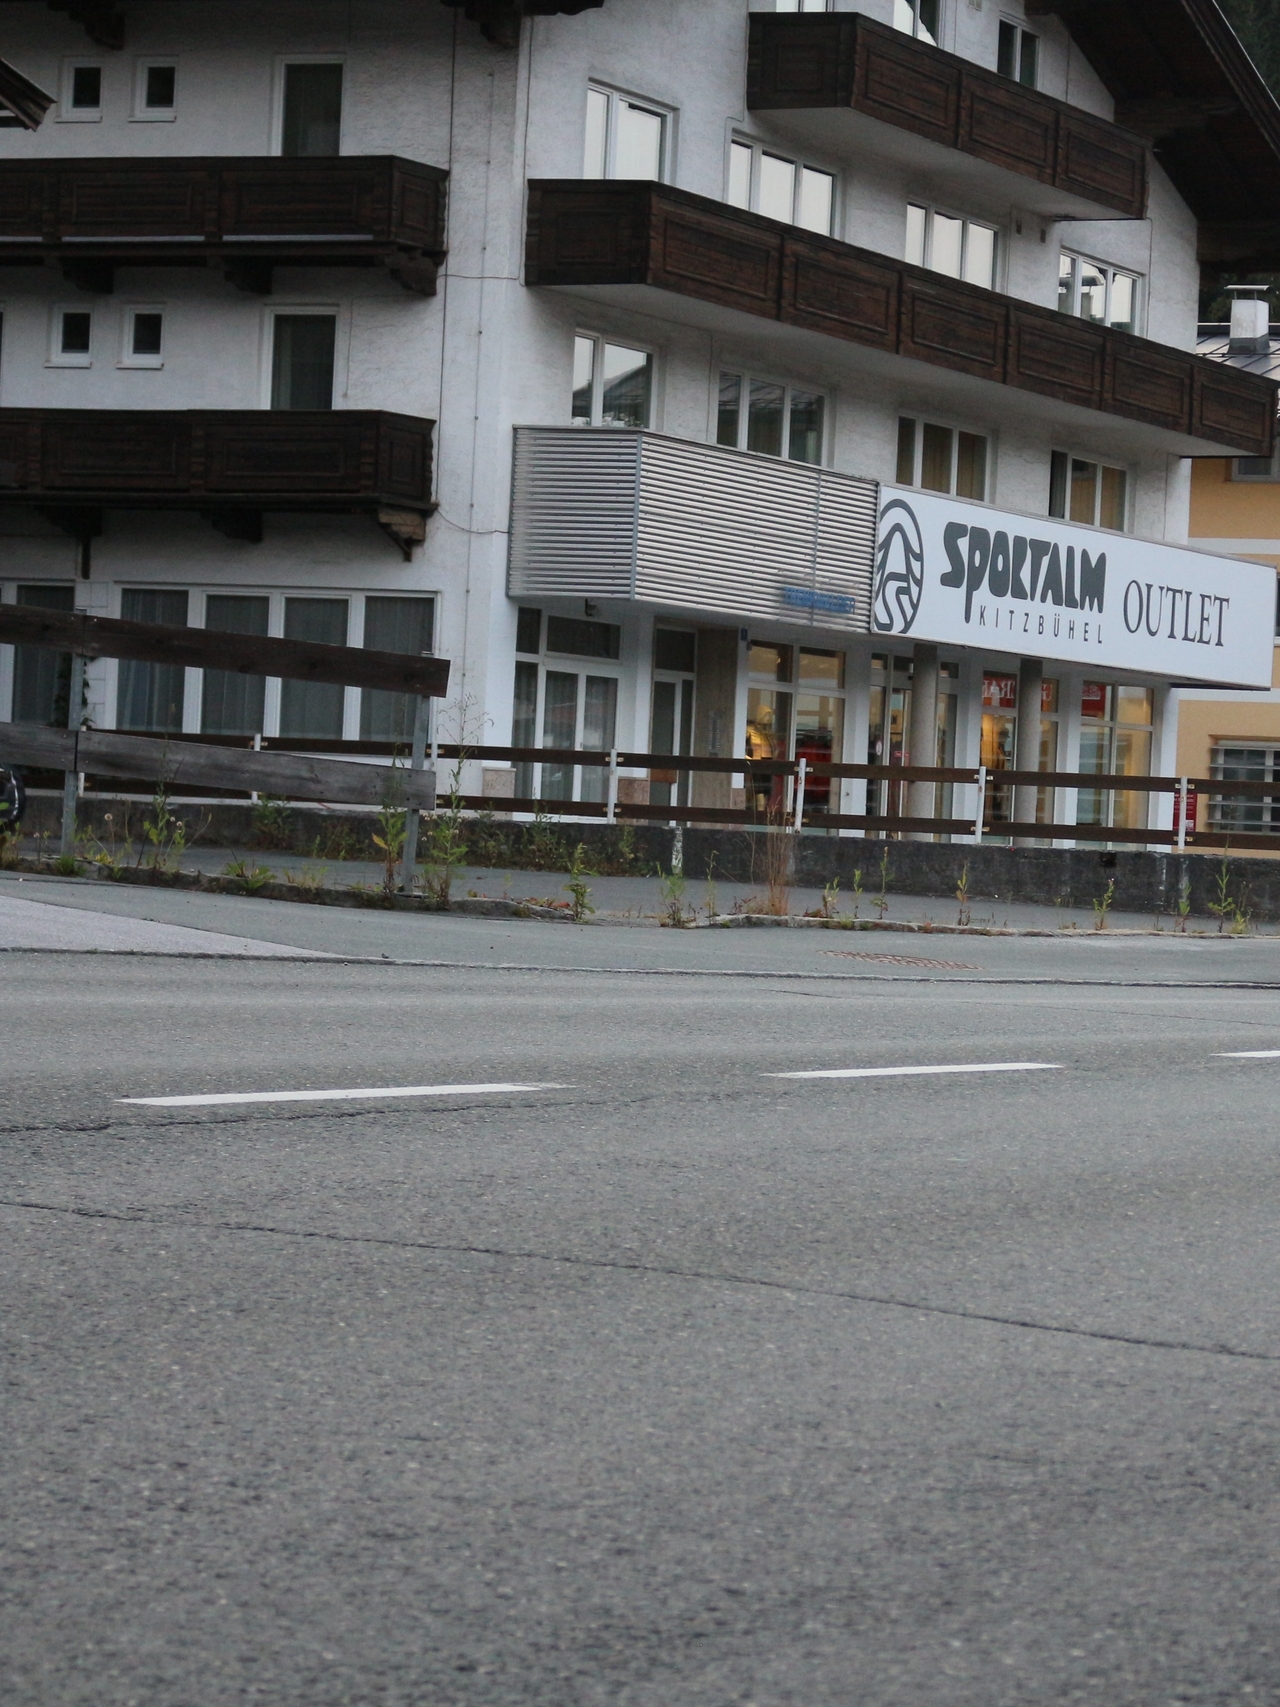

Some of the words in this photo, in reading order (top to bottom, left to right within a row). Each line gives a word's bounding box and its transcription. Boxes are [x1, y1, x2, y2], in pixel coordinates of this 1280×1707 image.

[940, 521, 1107, 624] SPORTALM
[978, 604, 1103, 645] KITZBÜHEL
[1123, 579, 1230, 647] OUTLET
